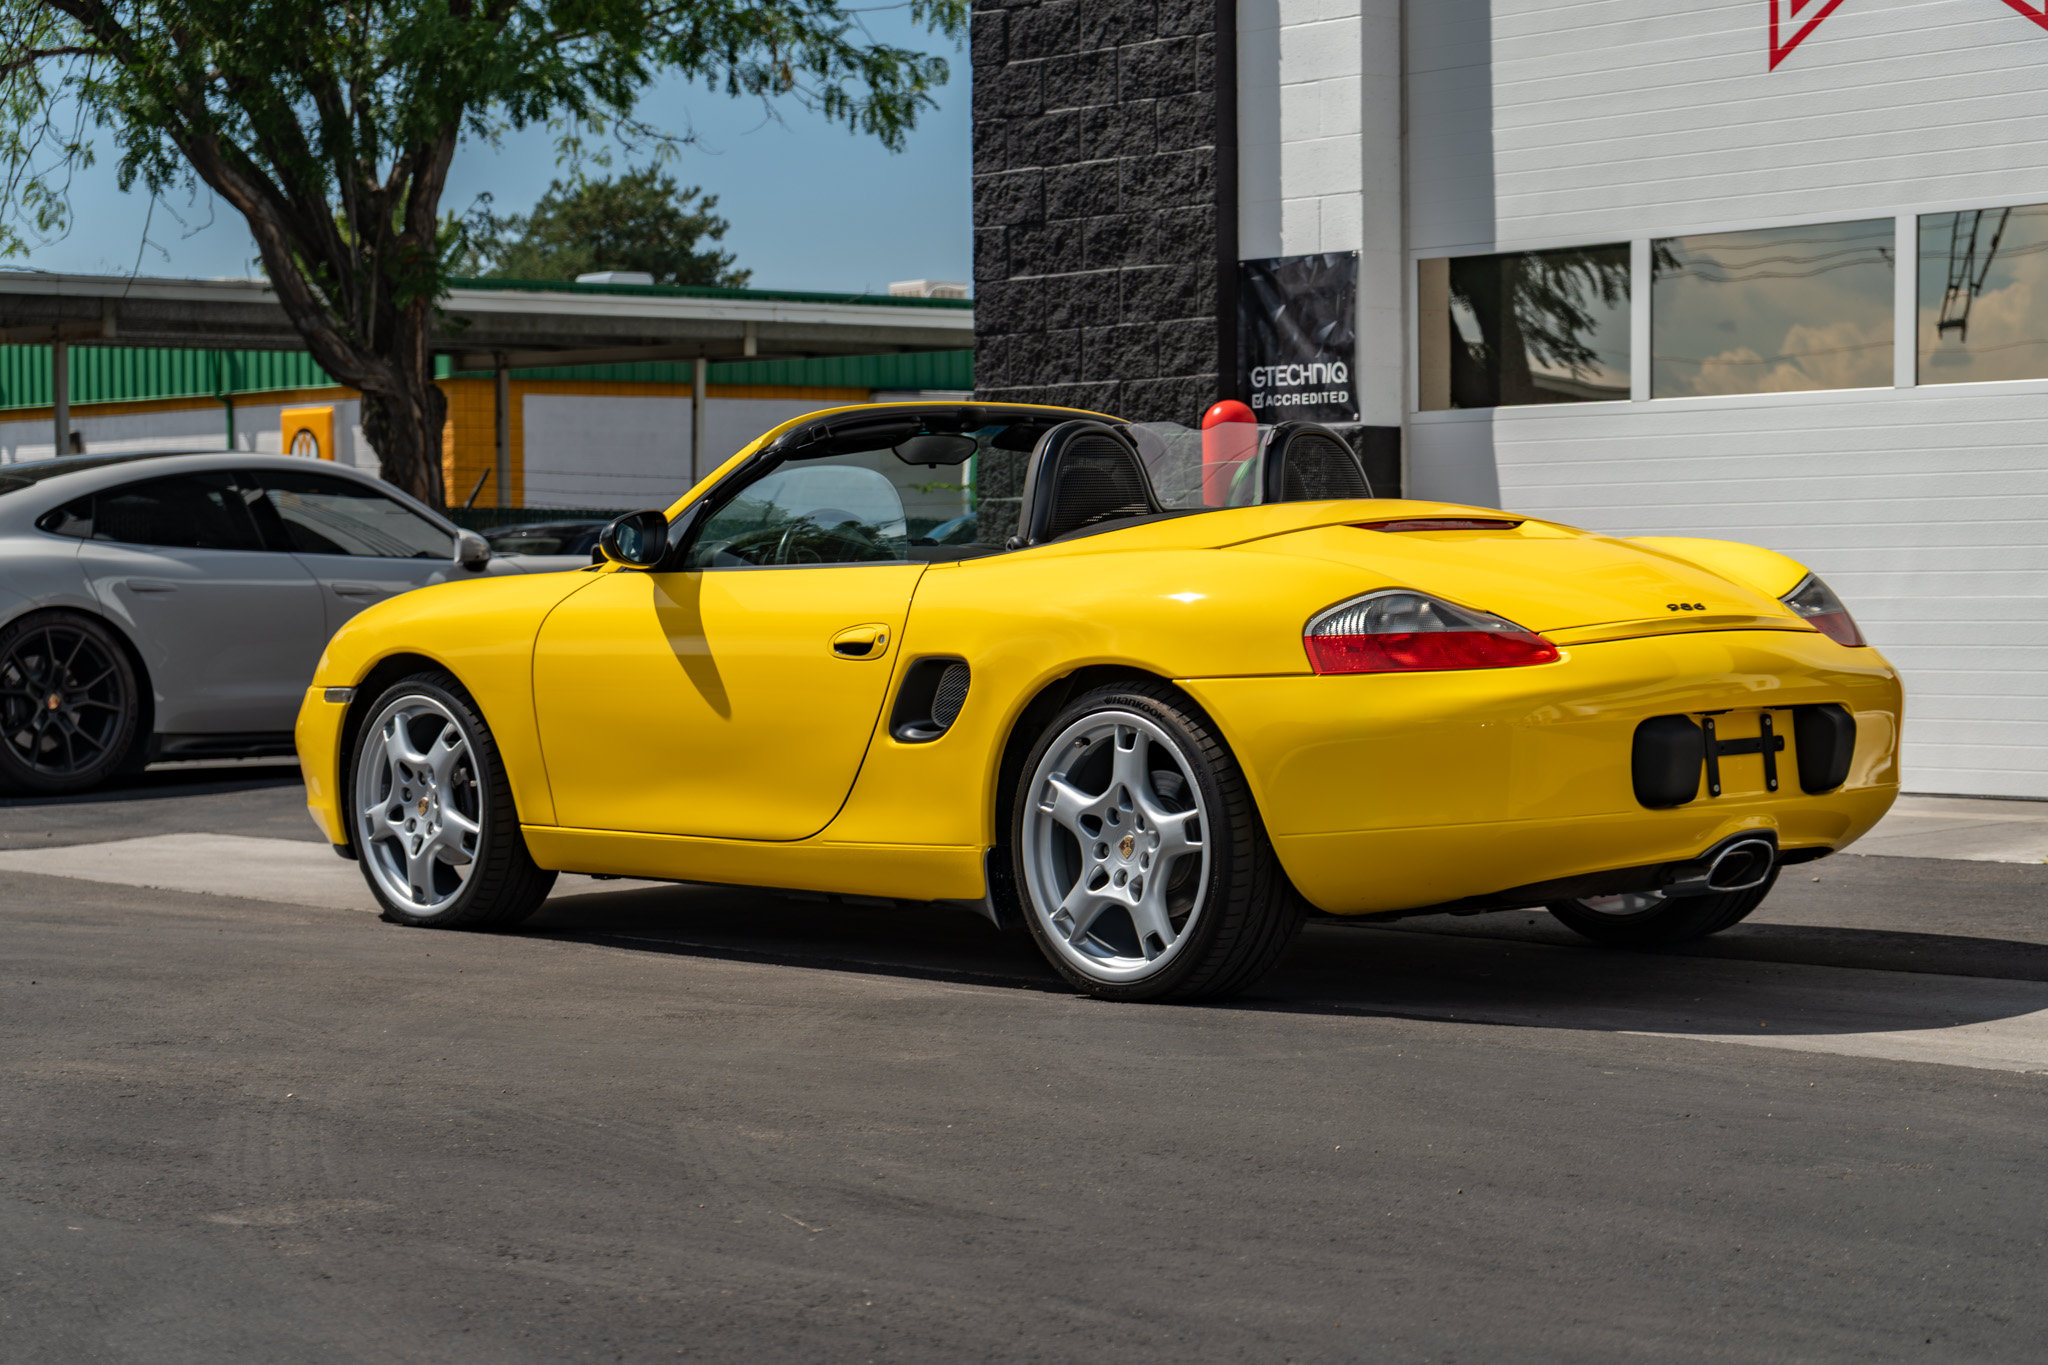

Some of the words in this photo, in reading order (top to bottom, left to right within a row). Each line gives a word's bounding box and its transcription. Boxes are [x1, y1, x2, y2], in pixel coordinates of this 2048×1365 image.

[1251, 362, 1348, 388] GTECHNIQ
[1265, 391, 1349, 407] ACCREDITED
[1666, 602, 1706, 611] 986
